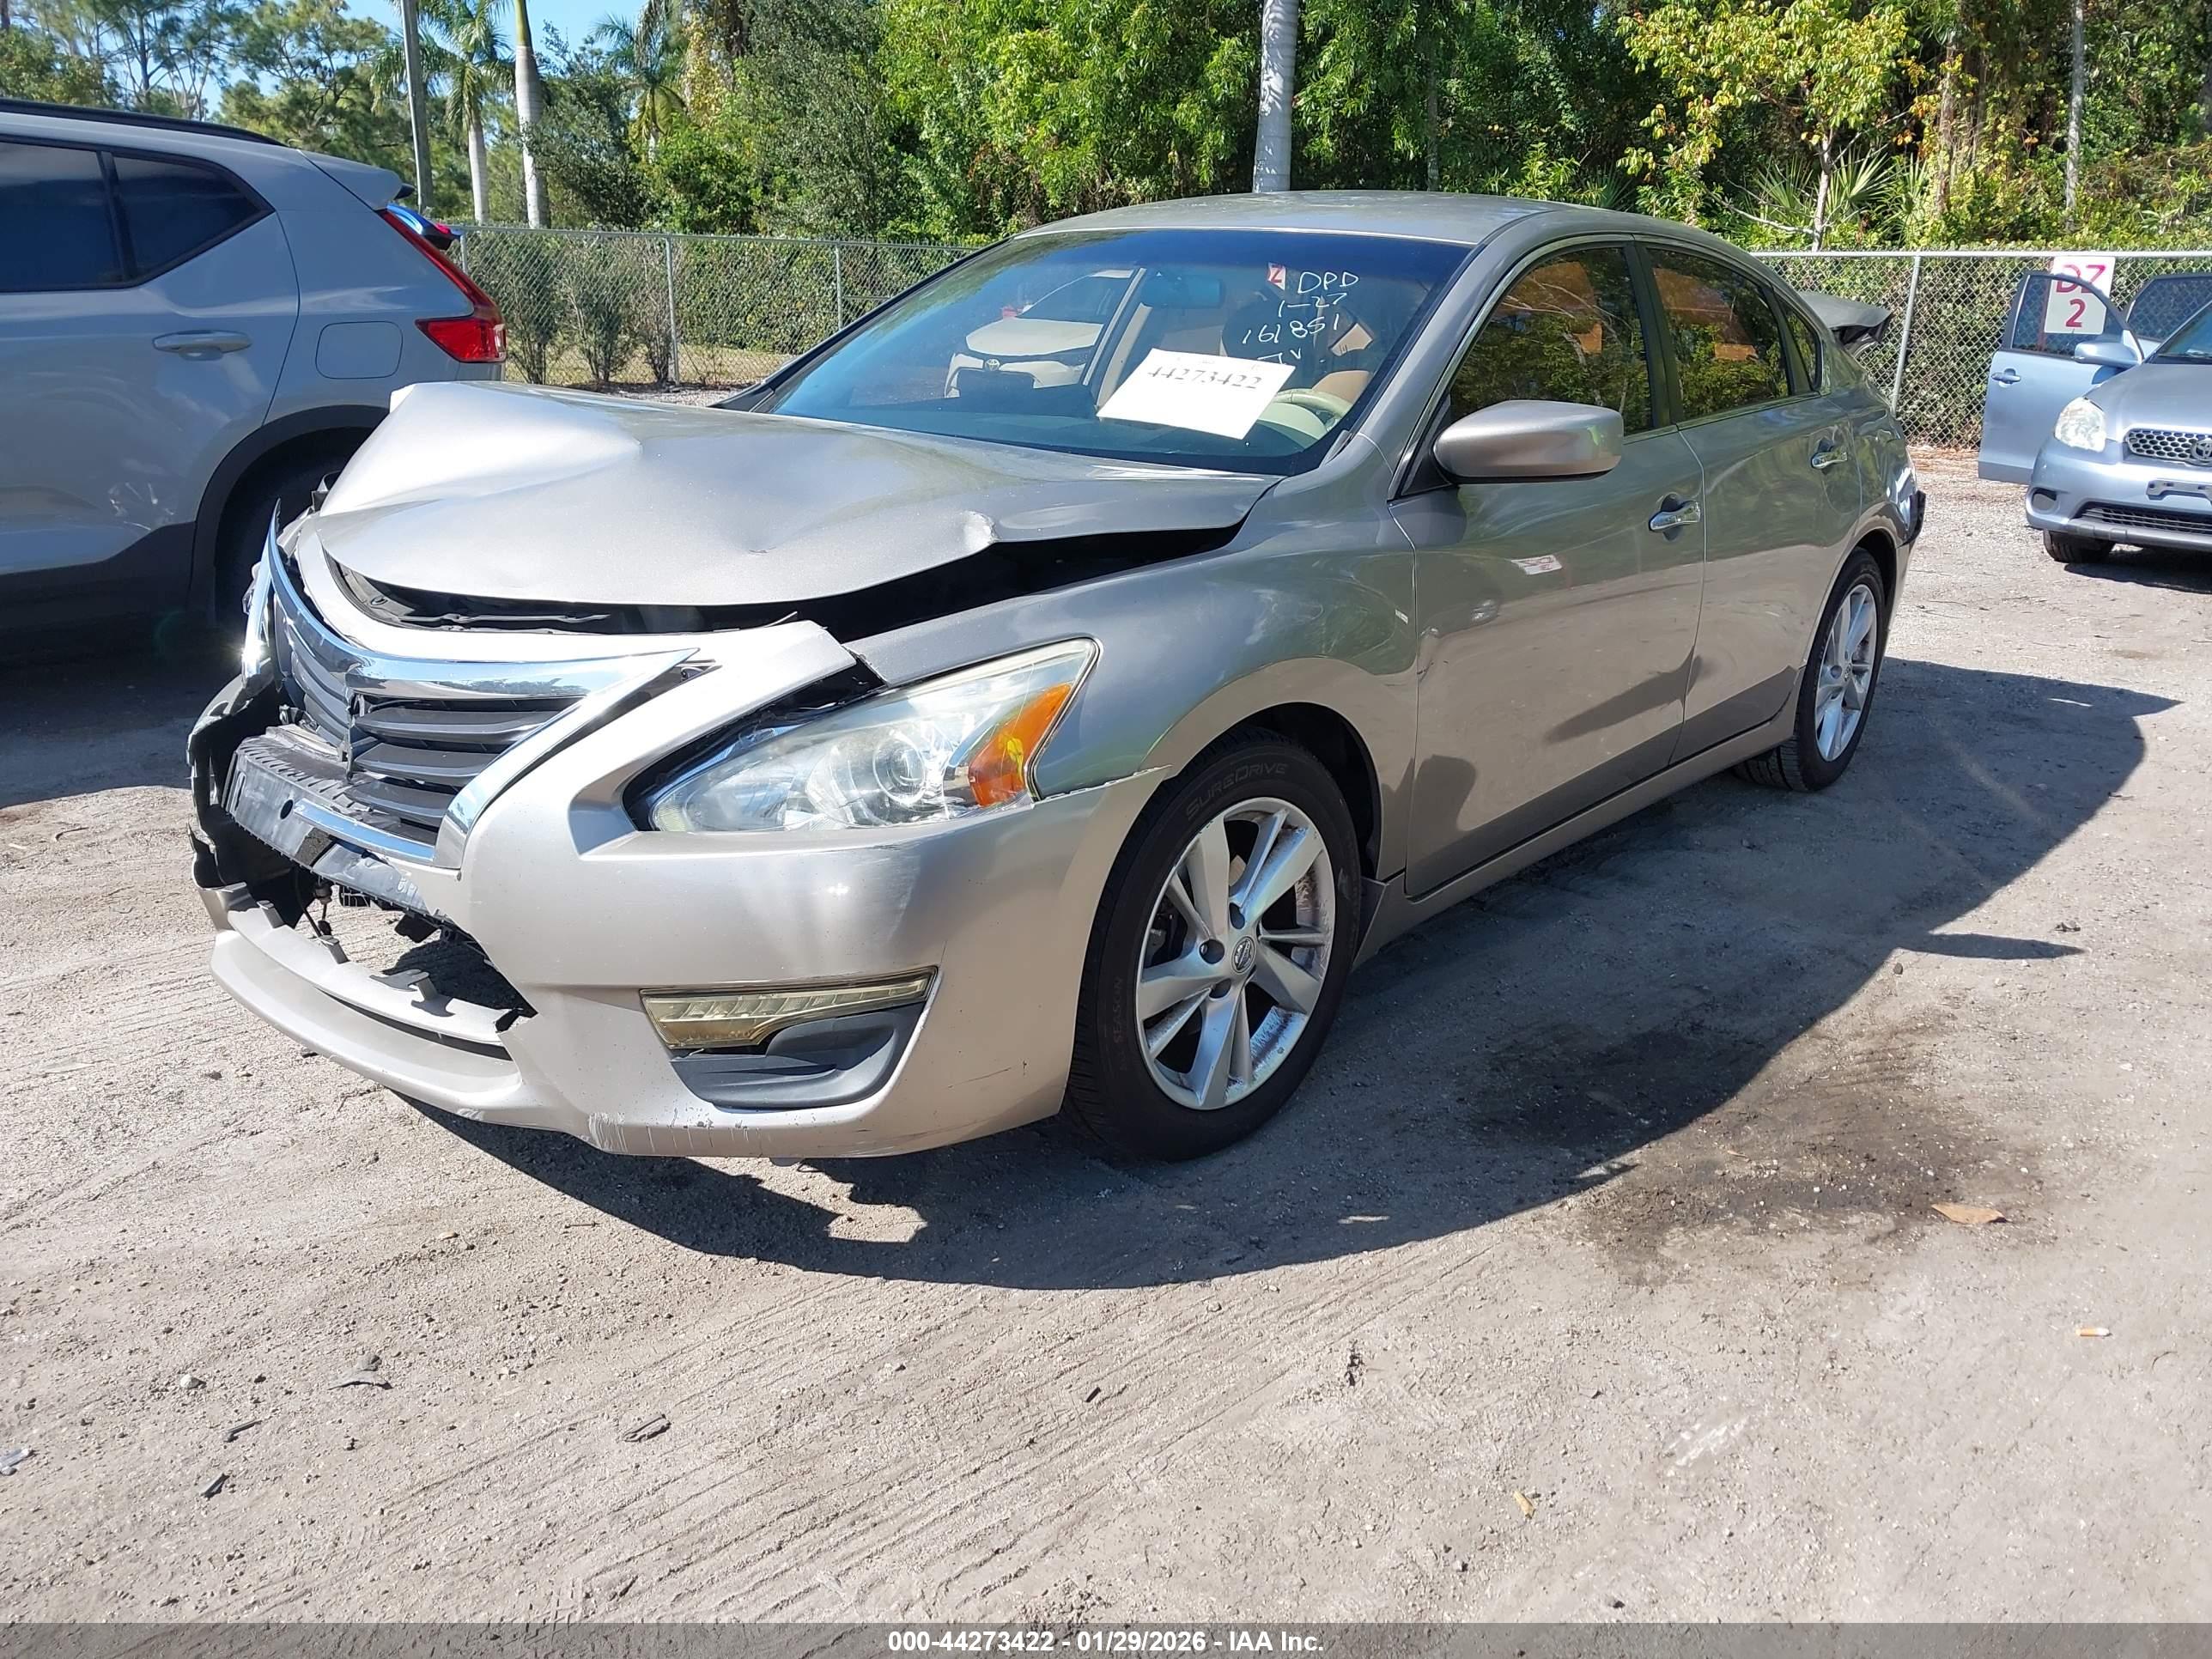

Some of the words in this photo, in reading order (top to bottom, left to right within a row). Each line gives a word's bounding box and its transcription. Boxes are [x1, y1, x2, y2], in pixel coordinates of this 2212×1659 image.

[1297, 271, 1359, 294] DPD
[1278, 293, 1347, 318] 1-27
[2065, 298, 2086, 327] 2
[1146, 366, 1262, 389] 44273422
[1186, 763, 1289, 822] SUREDRIVE
